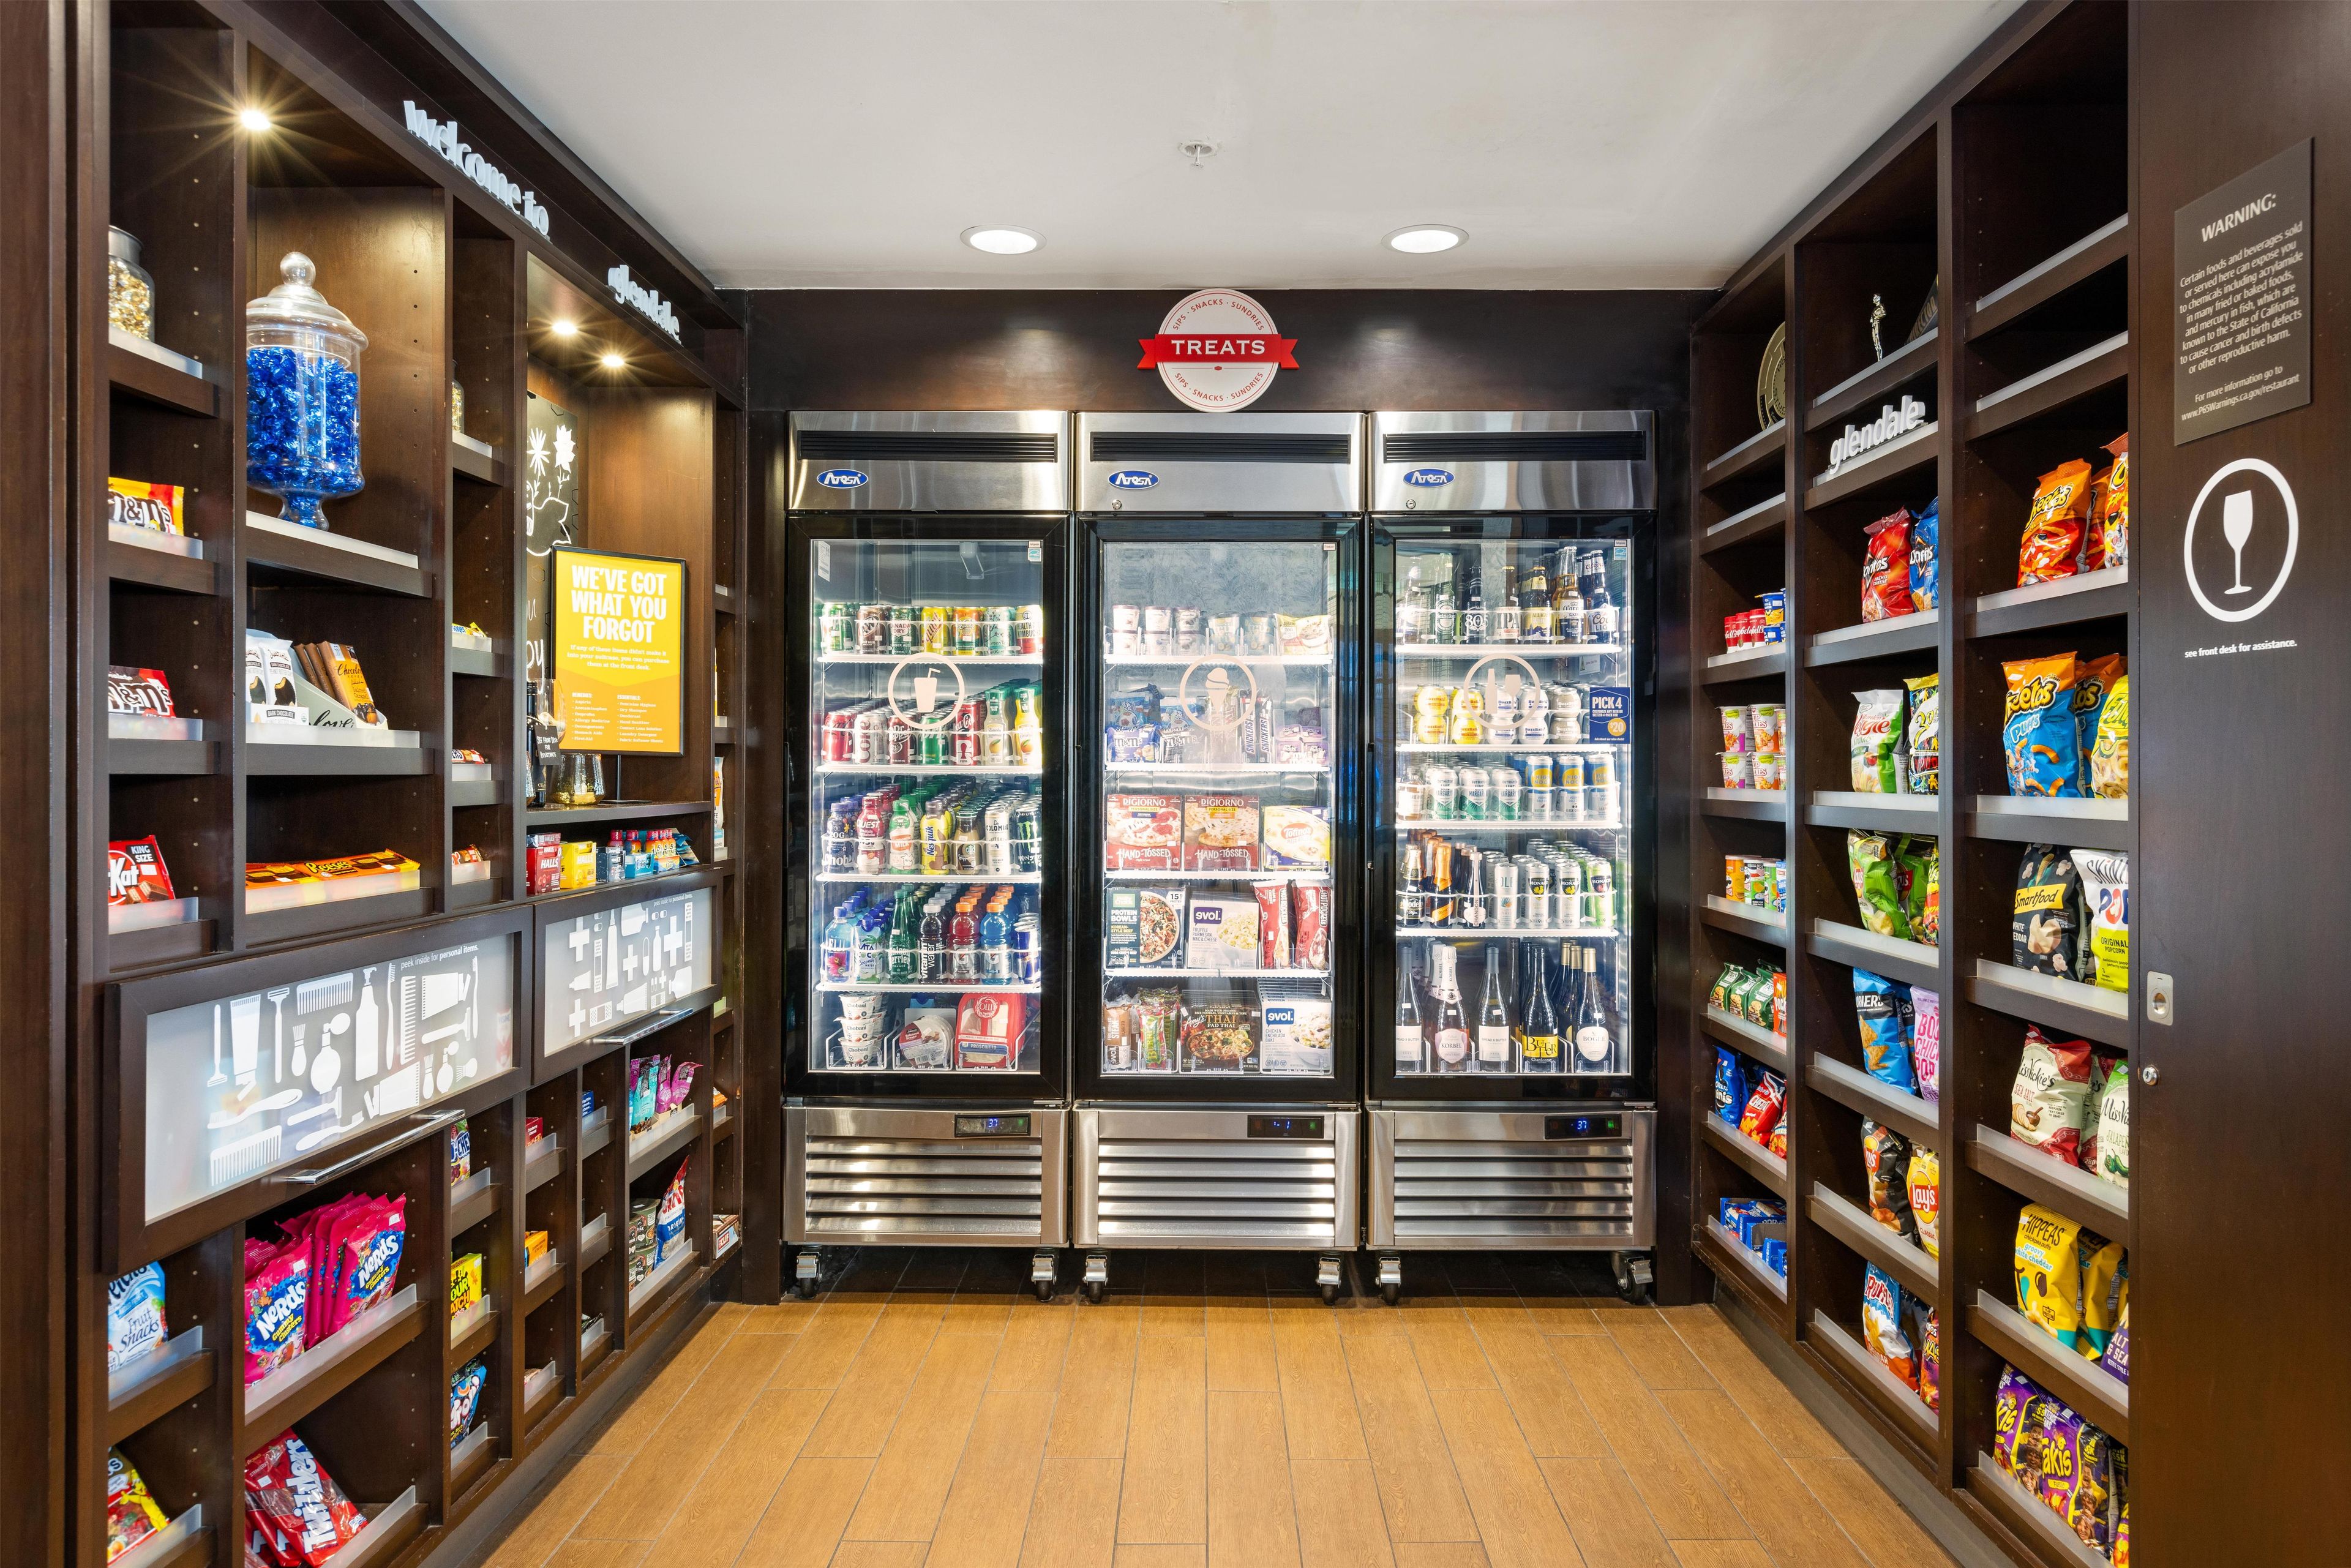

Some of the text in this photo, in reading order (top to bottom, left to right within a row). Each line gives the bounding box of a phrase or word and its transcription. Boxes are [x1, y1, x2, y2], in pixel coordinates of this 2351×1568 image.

[403, 100, 549, 236] welcome to
[2202, 193, 2276, 242] WARNING:
[2180, 220, 2303, 287] Certain foods and beverages sold
[2185, 241, 2297, 298] or served here can expose you
[2189, 287, 2222, 309] chemicals
[2224, 272, 2257, 293] including
[2259, 252, 2303, 278] acrylamide
[2195, 306, 2213, 320] many
[2216, 294, 2232, 311] fried
[2233, 293, 2241, 302] or
[2244, 280, 2267, 298] baked
[2269, 270, 2294, 288] foods,
[1172, 299, 1264, 331] SIPS SNACKS SUNDRIES
[2183, 296, 2299, 350] known to the State of California
[2185, 284, 2295, 337] and mercury in fish, which are
[1171, 340, 1265, 354] TREATS
[2180, 310, 2302, 364] to cause cancer and birth defects
[2199, 356, 2216, 371] other
[2218, 339, 2265, 362] reproductive
[2267, 329, 2290, 345] harm.
[1174, 372, 1264, 402] SIPS SNACKS SUNDRIES
[2195, 394, 2205, 402] For
[2207, 387, 2223, 399] more
[2224, 372, 2262, 392] information
[2264, 369, 2273, 380] go
[1829, 395, 1925, 475] glendale
[572, 565, 667, 596] WE'VE GOT
[571, 590, 667, 620] WHAT YOU
[583, 616, 655, 643] FORGOT
[1465, 614, 1489, 628] 805
[2199, 647, 2218, 656] front
[2219, 644, 2237, 654] desk
[2238, 643, 2251, 652] for
[2252, 640, 2297, 650] assistance.
[1592, 697, 1622, 709] PICK 4
[1245, 719, 1254, 755] SNICKERS
[1261, 716, 1270, 752] SNICKERS
[1610, 722, 1624, 732] $20
[131, 846, 151, 854] KING
[541, 858, 558, 869] HALLS
[1116, 849, 1171, 858] HAND-TOSSED
[1195, 848, 1249, 858] HAND-TOSSED
[2015, 889, 2059, 910] Smartfood
[401, 958, 414, 970] peek
[415, 955, 430, 965] inside
[440, 947, 462, 961] personal
[463, 945, 479, 954] items.
[2104, 946, 2126, 955] POPCORN
[1184, 1014, 1205, 1030] Amy's
[1205, 1015, 1236, 1024] THAI
[988, 1119, 998, 1128] 37
[1577, 1120, 1587, 1130] 37
[1913, 1182, 1937, 1214] Lay's
[2022, 1214, 2064, 1247] HIPPEAS
[2023, 1234, 2051, 1250] chickpea puffs
[2024, 1242, 2044, 1257] groovy
[2028, 1253, 2052, 1272] cheddar
[128, 1307, 152, 1334] Fruit
[119, 1319, 159, 1352] Snacks
